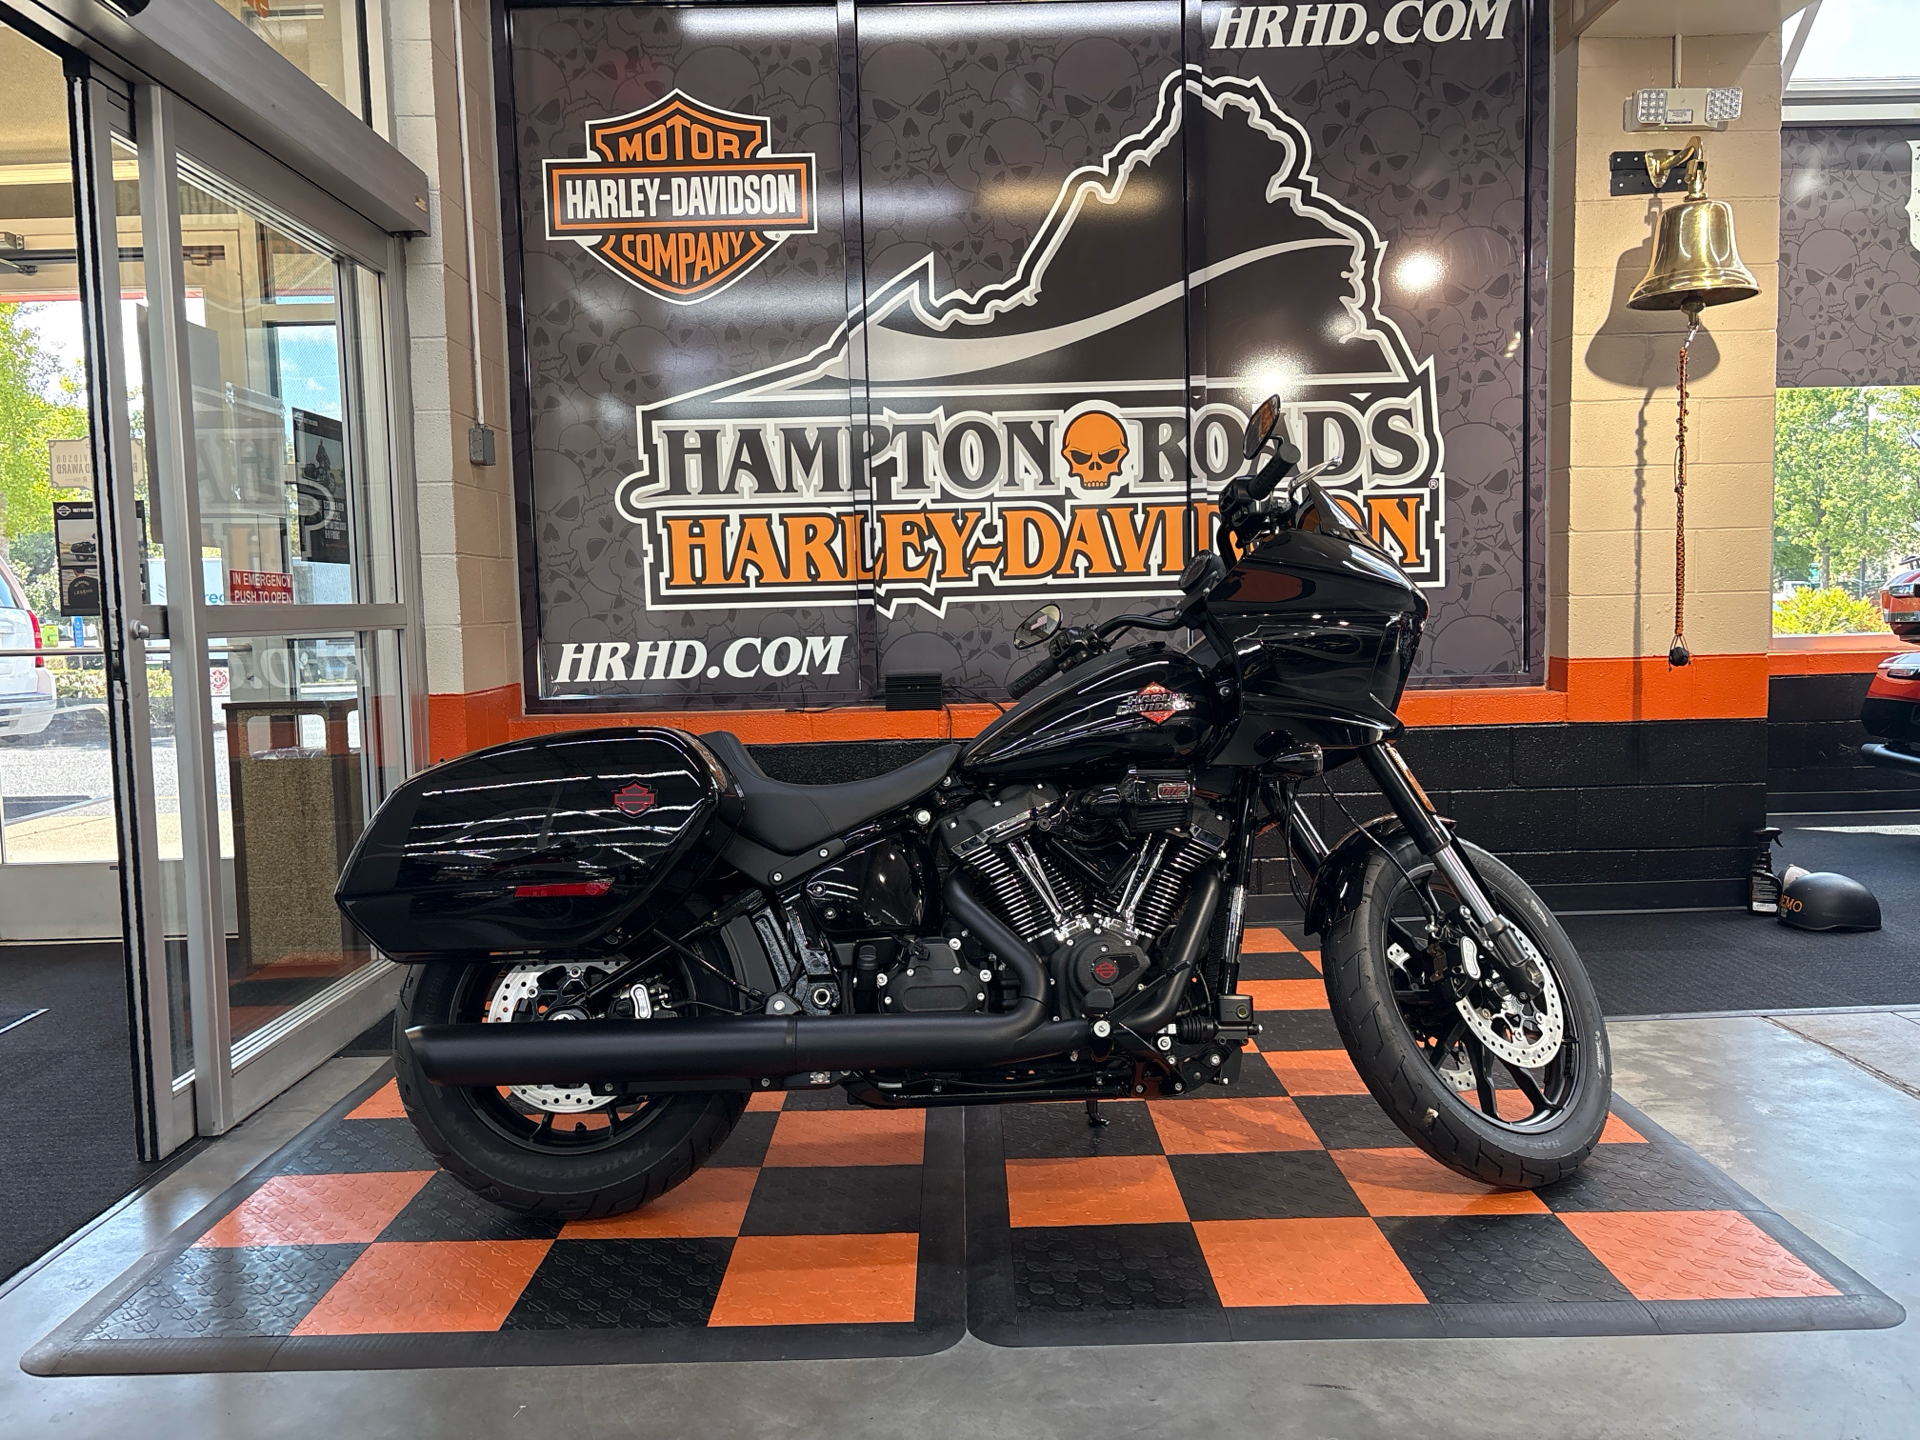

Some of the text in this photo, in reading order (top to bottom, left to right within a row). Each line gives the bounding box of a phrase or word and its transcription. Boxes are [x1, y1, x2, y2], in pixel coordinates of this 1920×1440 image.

[1209, 0, 1511, 49] HRHD.COM
[618, 113, 741, 162] MOTOR
[565, 173, 797, 220] HARLEY-DAVIDSON
[621, 230, 746, 286] COMPANY
[660, 418, 1058, 497] HAMPTON
[232, 572, 292, 588] IN EMERGENCY
[234, 590, 292, 604] PUSH TO OPEN
[551, 636, 848, 683] HRHD.COM
